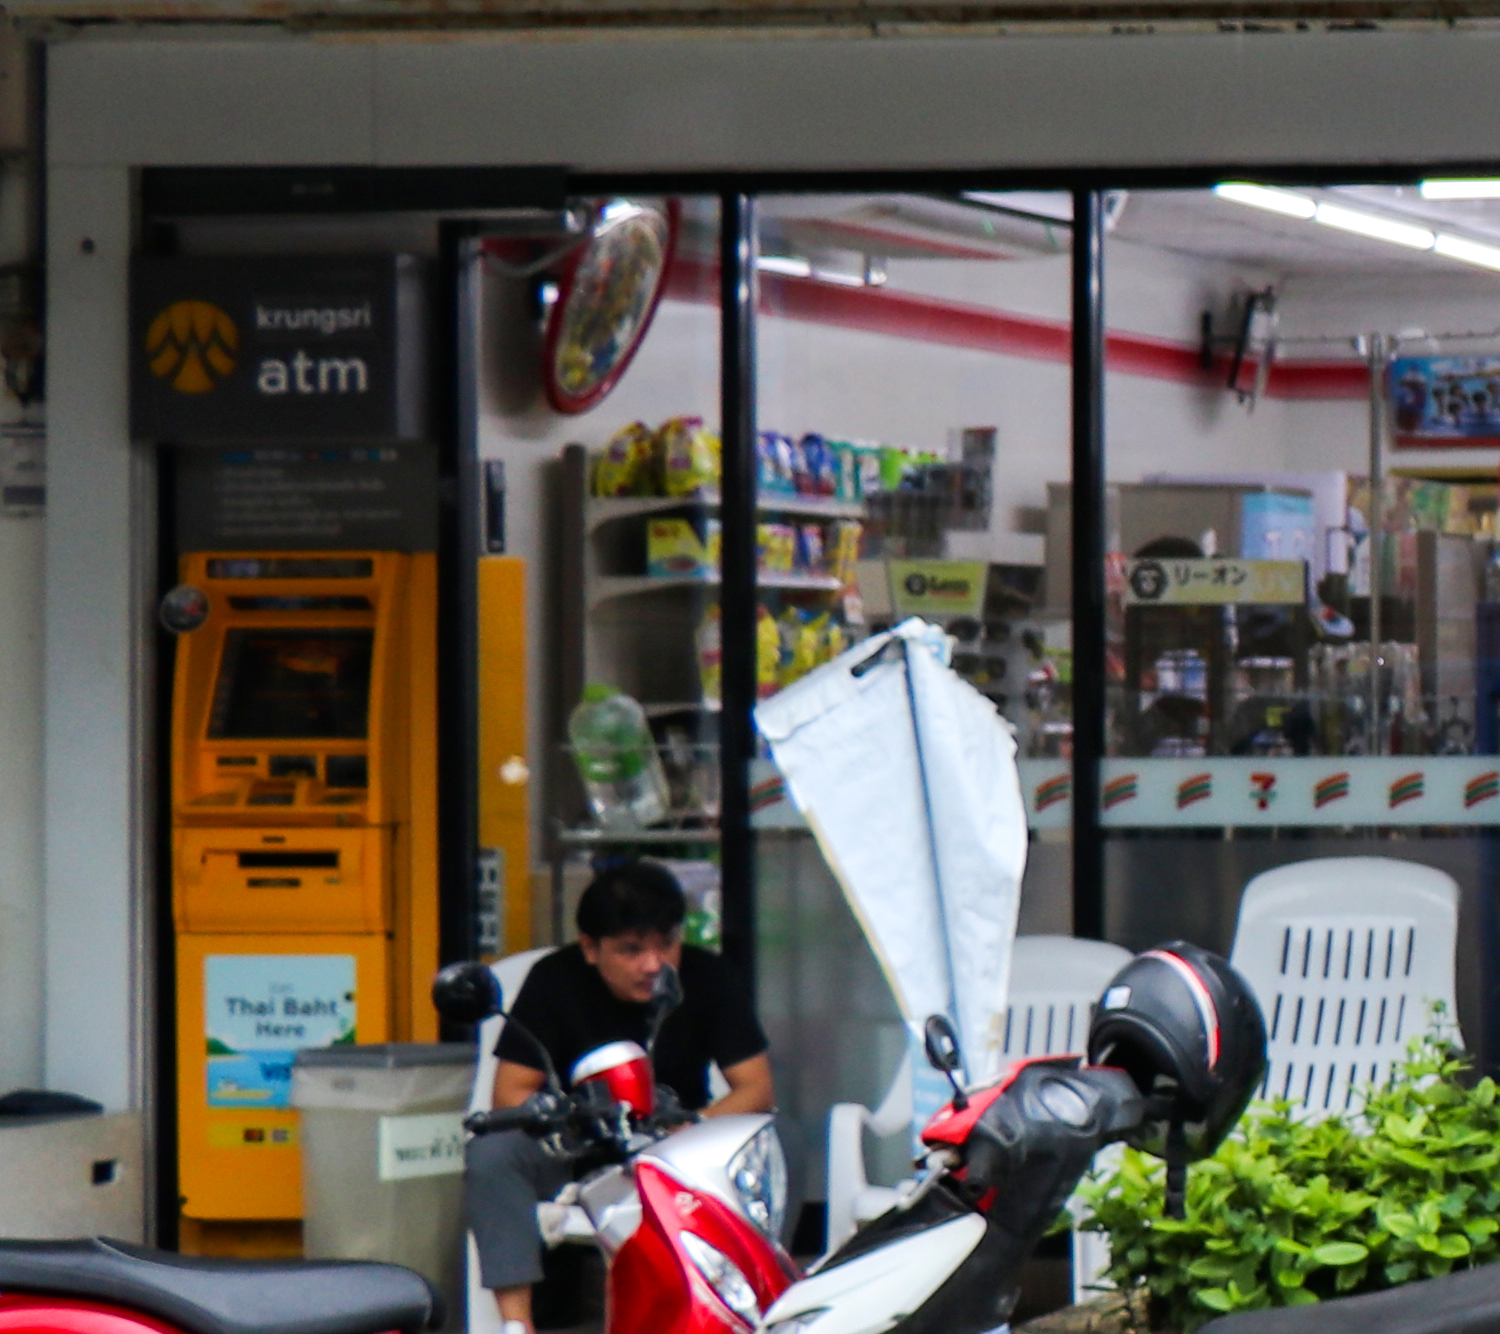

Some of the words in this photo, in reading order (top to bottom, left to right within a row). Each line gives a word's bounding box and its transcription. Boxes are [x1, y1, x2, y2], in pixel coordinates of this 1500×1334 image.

[255, 301, 372, 332] krungsri
[256, 350, 369, 396] atm
[225, 996, 276, 1016] Thai
[283, 996, 339, 1016] Baht
[255, 1022, 307, 1038] Here
